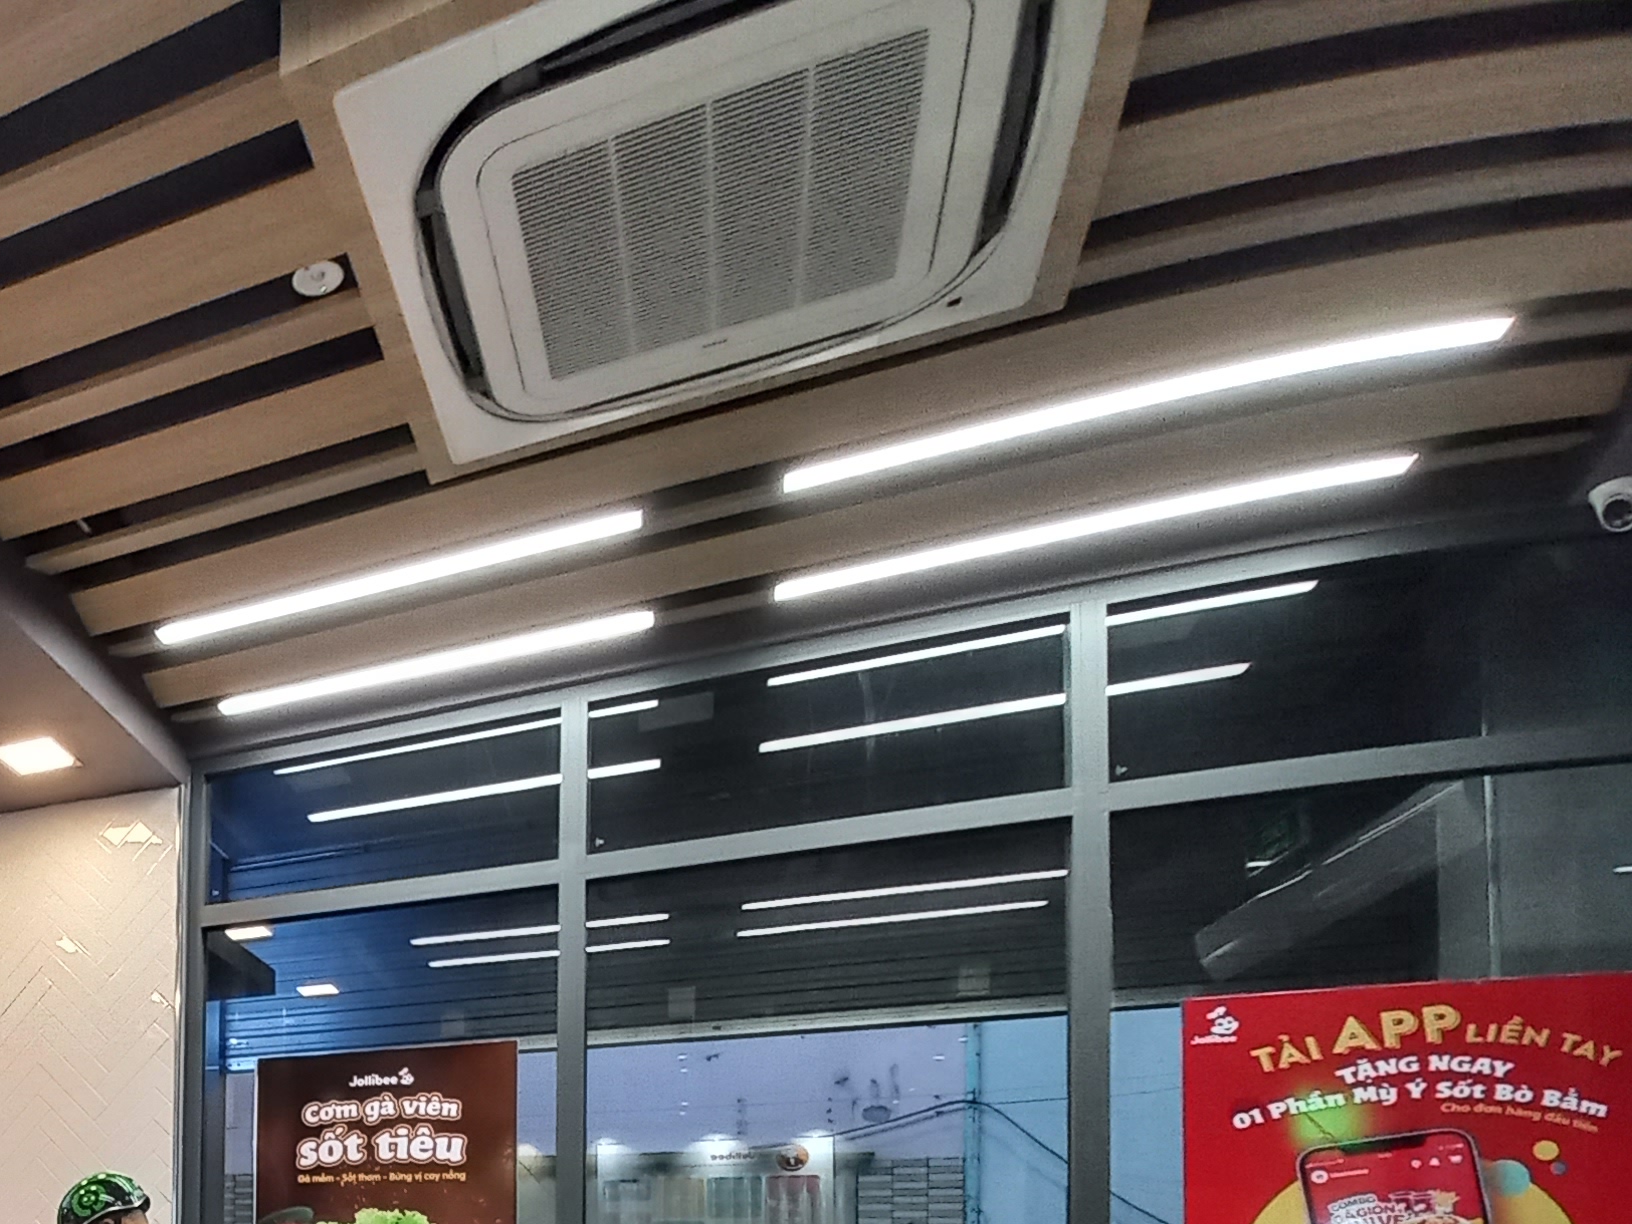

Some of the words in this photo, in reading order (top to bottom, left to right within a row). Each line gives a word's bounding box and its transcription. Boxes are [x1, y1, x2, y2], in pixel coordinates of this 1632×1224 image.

[1250, 1034, 1324, 1073] TẢI
[1332, 1004, 1462, 1055] APP
[1465, 1014, 1551, 1048] LIỀN
[1560, 1031, 1623, 1067] TAY
[348, 1073, 398, 1088] Jollibee
[1334, 1055, 1420, 1085] TẶNG
[1428, 1054, 1515, 1078] NGAY
[304, 1102, 359, 1123] Cơm
[365, 1095, 396, 1121] gà
[402, 1096, 459, 1118] viên
[1232, 1107, 1265, 1129] 01
[1267, 1089, 1347, 1120] Phần
[1352, 1083, 1398, 1106] Mỳ
[1405, 1076, 1428, 1099] Ý
[1435, 1078, 1487, 1099] Sốt
[1494, 1083, 1534, 1103] Bò
[1540, 1086, 1608, 1118] Bằm
[298, 1127, 365, 1167] sốt
[375, 1127, 464, 1163] tiêu
